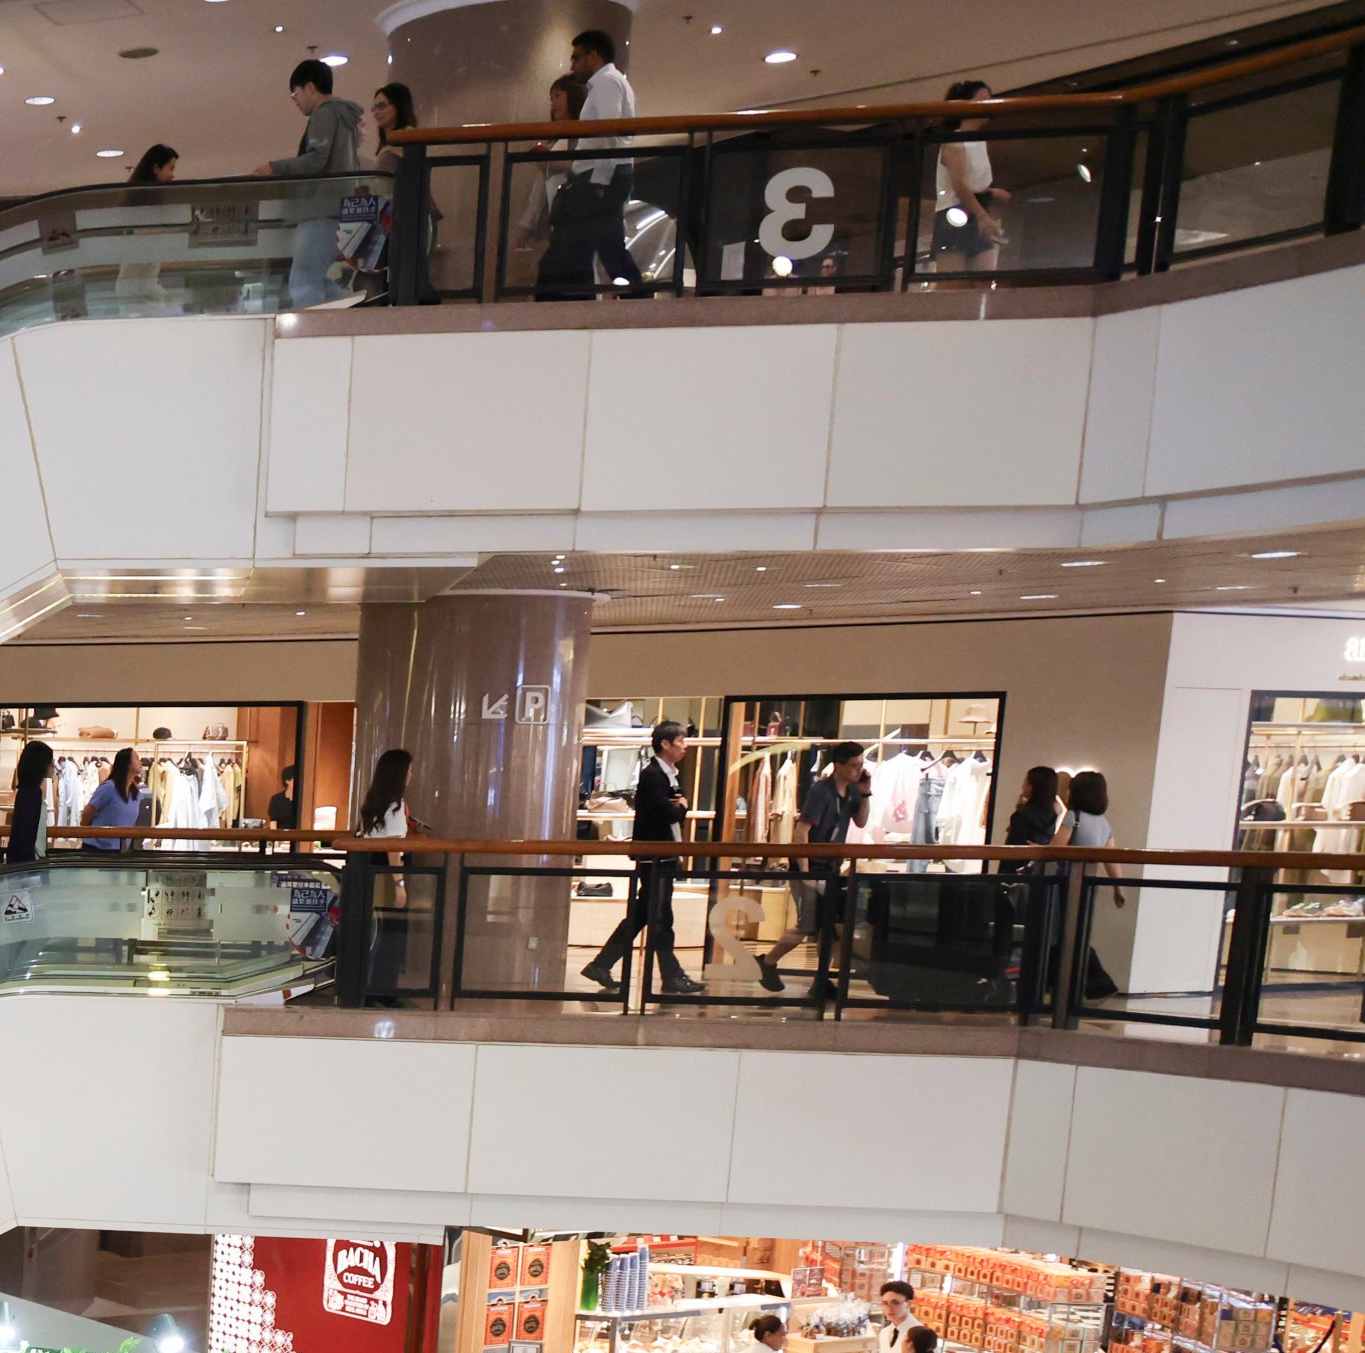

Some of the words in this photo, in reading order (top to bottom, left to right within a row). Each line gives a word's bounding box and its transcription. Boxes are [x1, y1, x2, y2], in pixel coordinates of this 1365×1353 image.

[525, 691, 545, 718] P
[336, 1246, 382, 1284] BACHA
[343, 1272, 375, 1289] COFFEE
